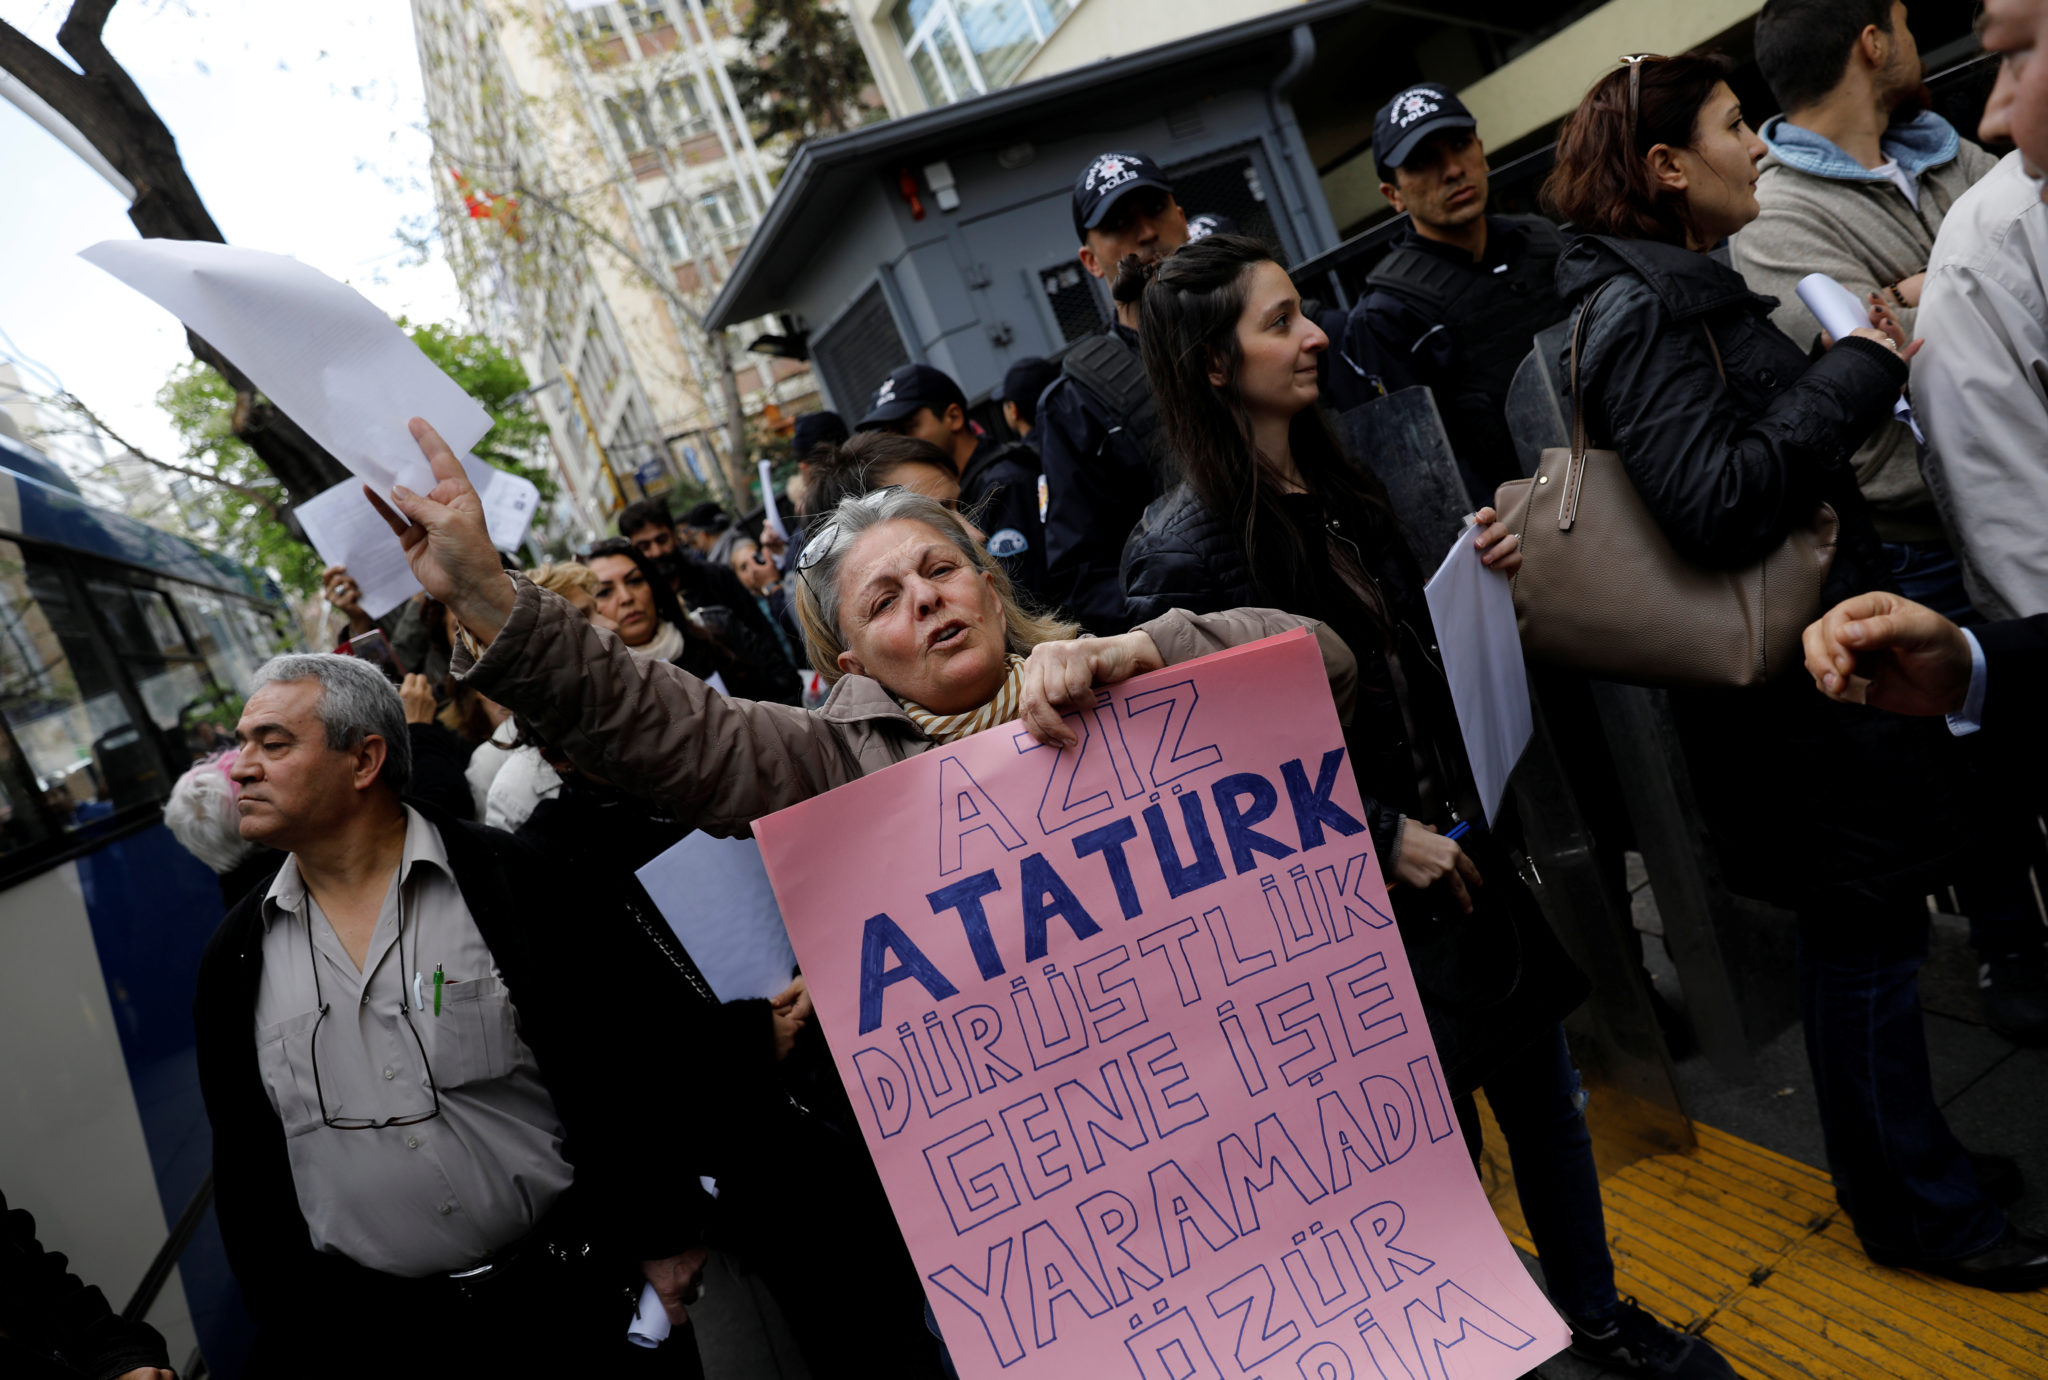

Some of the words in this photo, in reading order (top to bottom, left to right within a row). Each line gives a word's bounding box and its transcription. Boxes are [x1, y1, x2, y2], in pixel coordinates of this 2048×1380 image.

[1098, 170, 1138, 196] POLİS
[858, 747, 1366, 1036] ATATÜRK
[939, 679, 1223, 877] AZİZ
[852, 852, 1394, 1140] DÜRÜSTLÜK
[922, 1033, 1208, 1237] GENE
[1214, 952, 1408, 1098] İŞE
[928, 1055, 1453, 1369] YARAMADI
[1123, 1200, 1436, 1380] ÖZÜR
